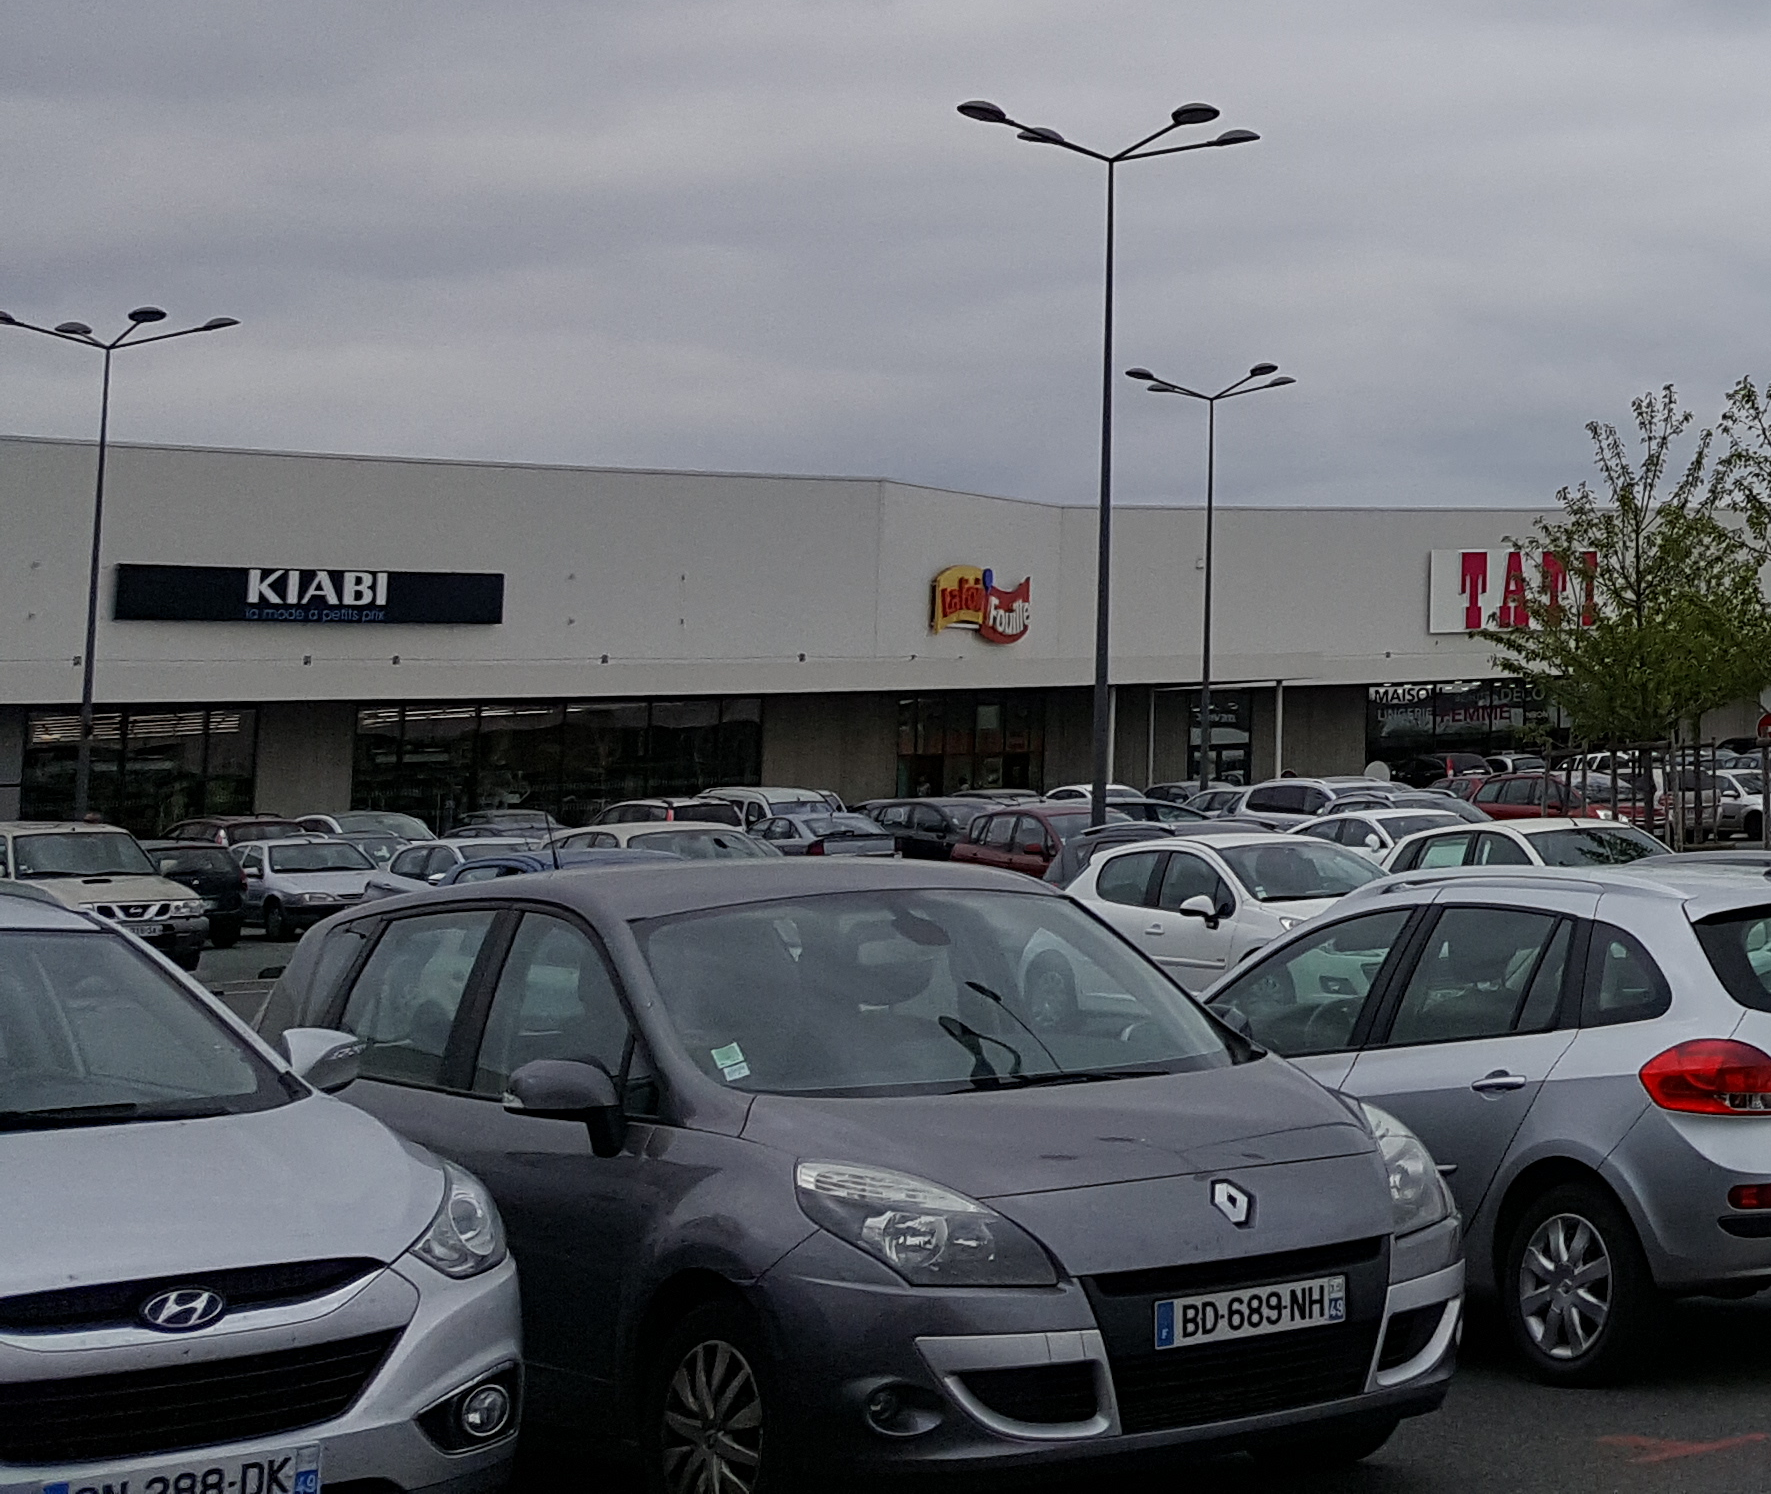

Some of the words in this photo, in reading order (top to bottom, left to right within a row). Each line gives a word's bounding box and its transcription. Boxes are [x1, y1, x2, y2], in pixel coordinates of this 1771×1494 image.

[247, 569, 388, 606] KIABI
[263, 607, 304, 620] mode
[322, 609, 359, 623] petits
[362, 610, 385, 623] prix
[1182, 1285, 1325, 1338] BD-689-NH
